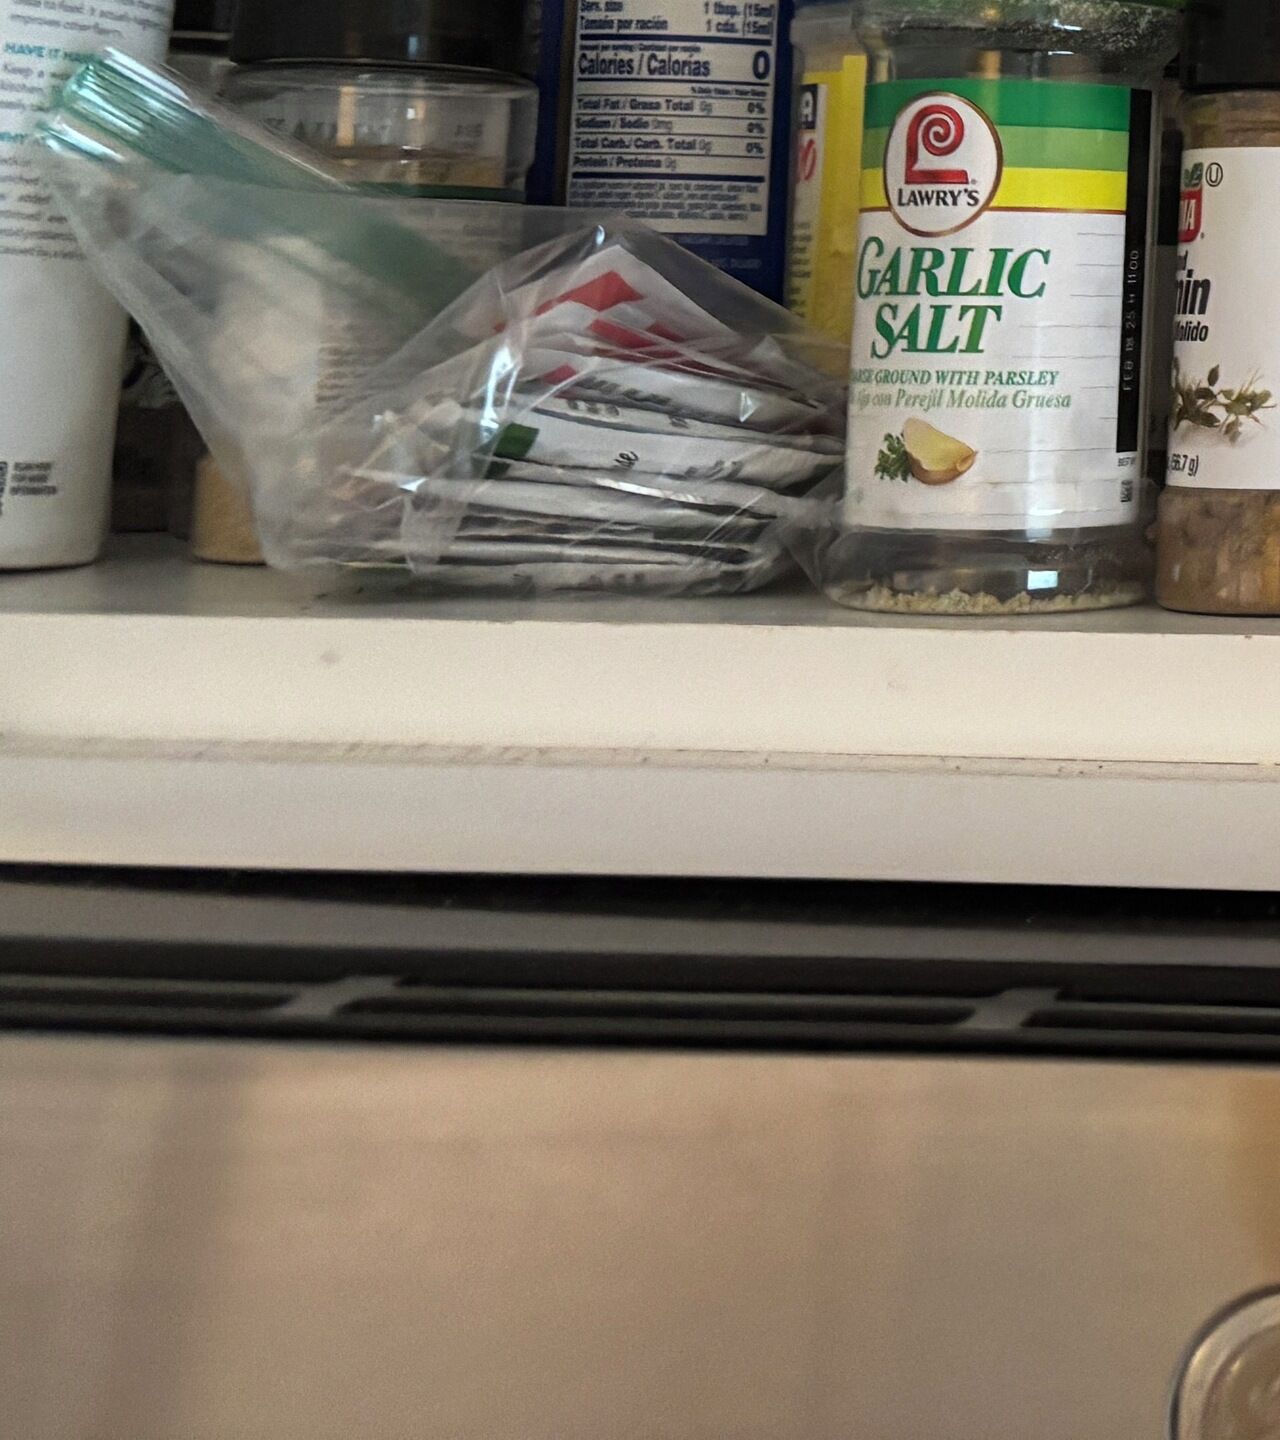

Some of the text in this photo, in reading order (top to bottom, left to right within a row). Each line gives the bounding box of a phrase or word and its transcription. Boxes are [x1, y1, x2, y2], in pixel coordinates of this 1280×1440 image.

[578, 50, 770, 80] Calories Calorías 0
[578, 99, 600, 110] Total
[603, 99, 619, 109] Fat
[666, 99, 694, 111] Total
[575, 138, 696, 149] Total Total
[897, 188, 980, 208] LAWRY'S
[857, 236, 1051, 299] GARLIC
[871, 303, 1003, 359] SALT
[875, 370, 1058, 386] GROUND WITH PARSLEY
[1123, 361, 1134, 391] FEB
[895, 389, 1071, 412] Perejil Molida Gruesa
